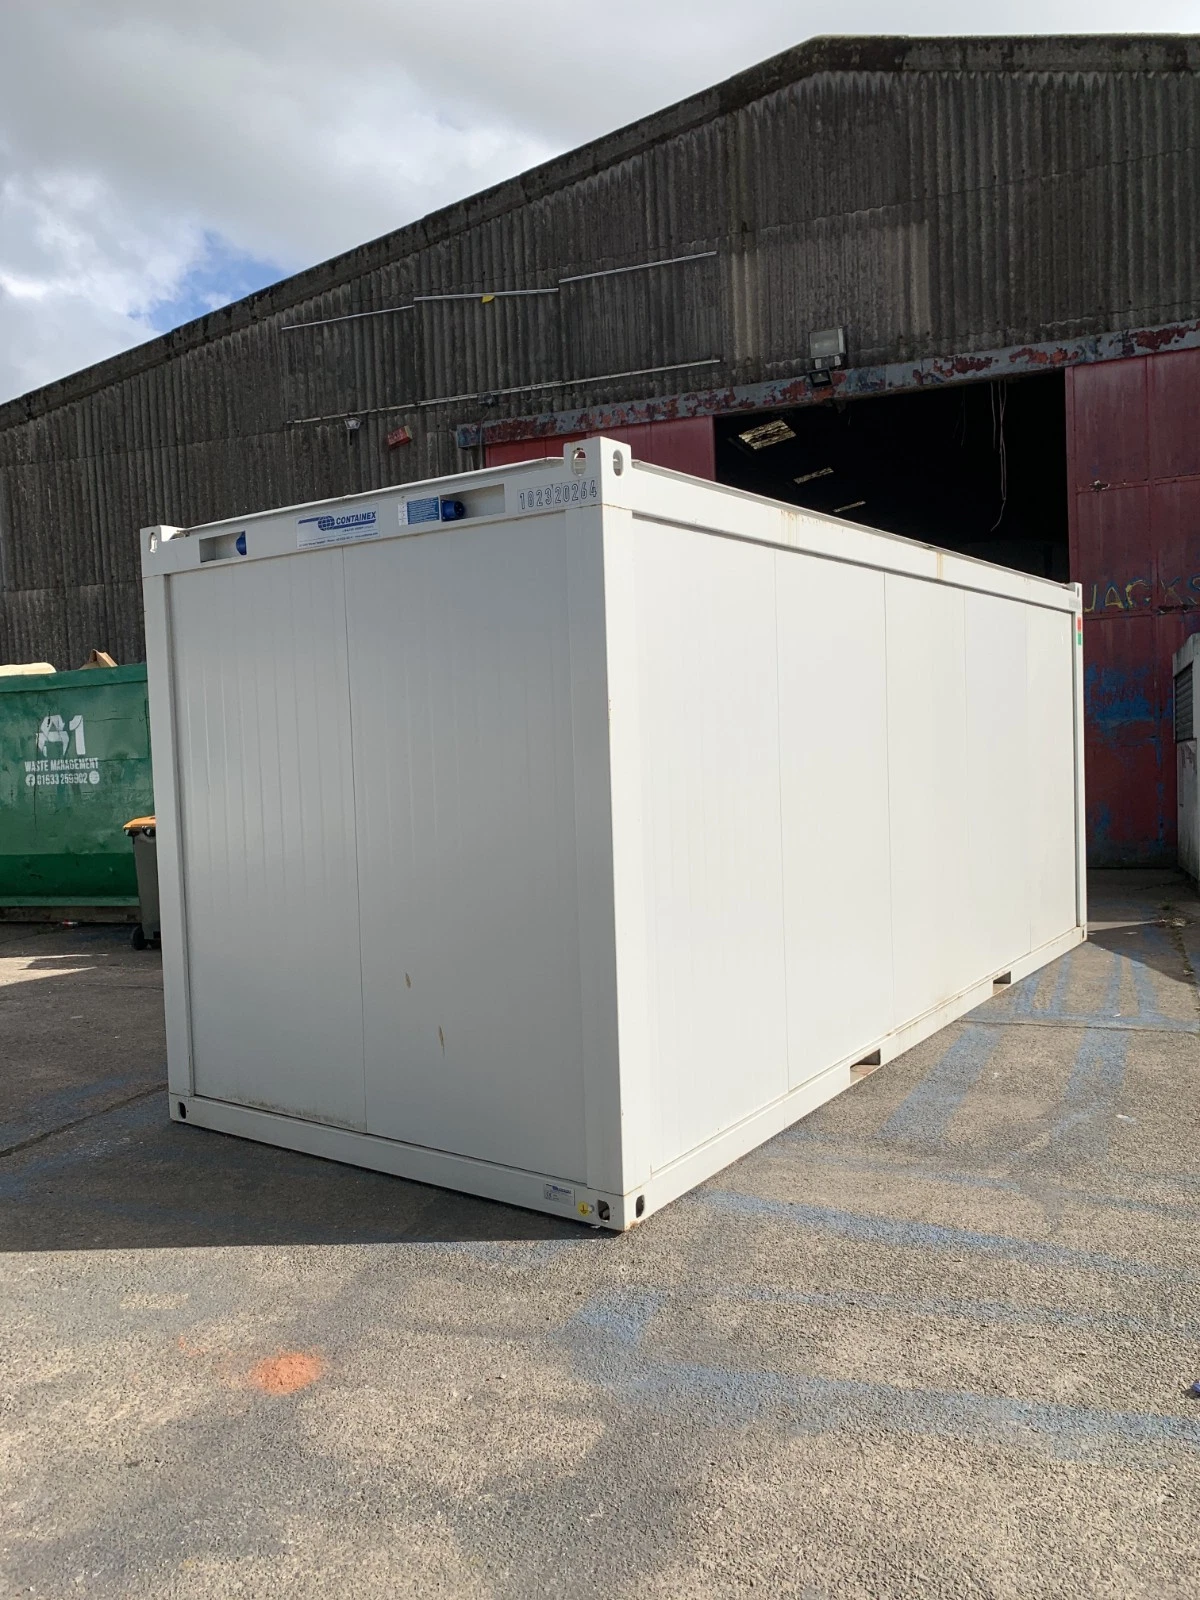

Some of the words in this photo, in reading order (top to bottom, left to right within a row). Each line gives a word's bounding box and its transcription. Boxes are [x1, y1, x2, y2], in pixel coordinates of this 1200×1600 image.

[336, 511, 377, 525] CONTAINEX
[36, 714, 86, 757] A1
[24, 760, 49, 772] WASTE
[50, 757, 99, 771] MANAGEMENT
